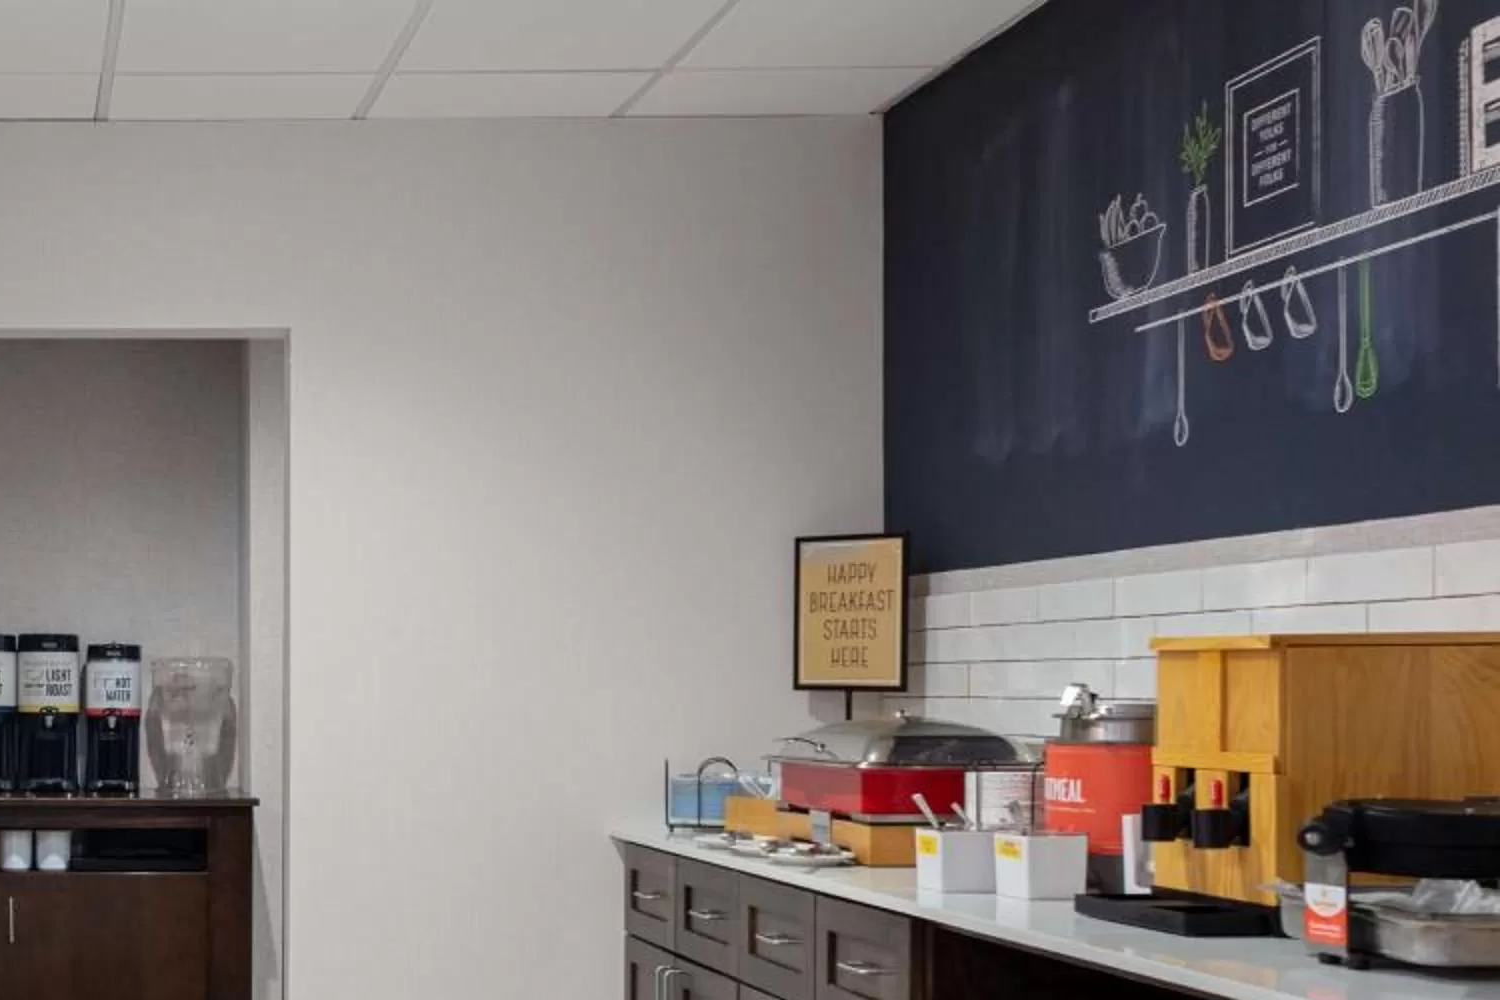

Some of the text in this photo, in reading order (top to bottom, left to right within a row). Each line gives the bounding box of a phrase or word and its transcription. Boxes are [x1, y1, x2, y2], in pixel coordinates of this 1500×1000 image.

[827, 561, 877, 585] HAPPY
[809, 589, 895, 613] BREAKFAST
[823, 617, 877, 641] STARTS
[830, 645, 869, 668] HERE
[45, 668, 72, 682] LIGHT
[116, 677, 132, 689] HOT
[45, 683, 72, 697] ROAST
[105, 690, 132, 702] WATER
